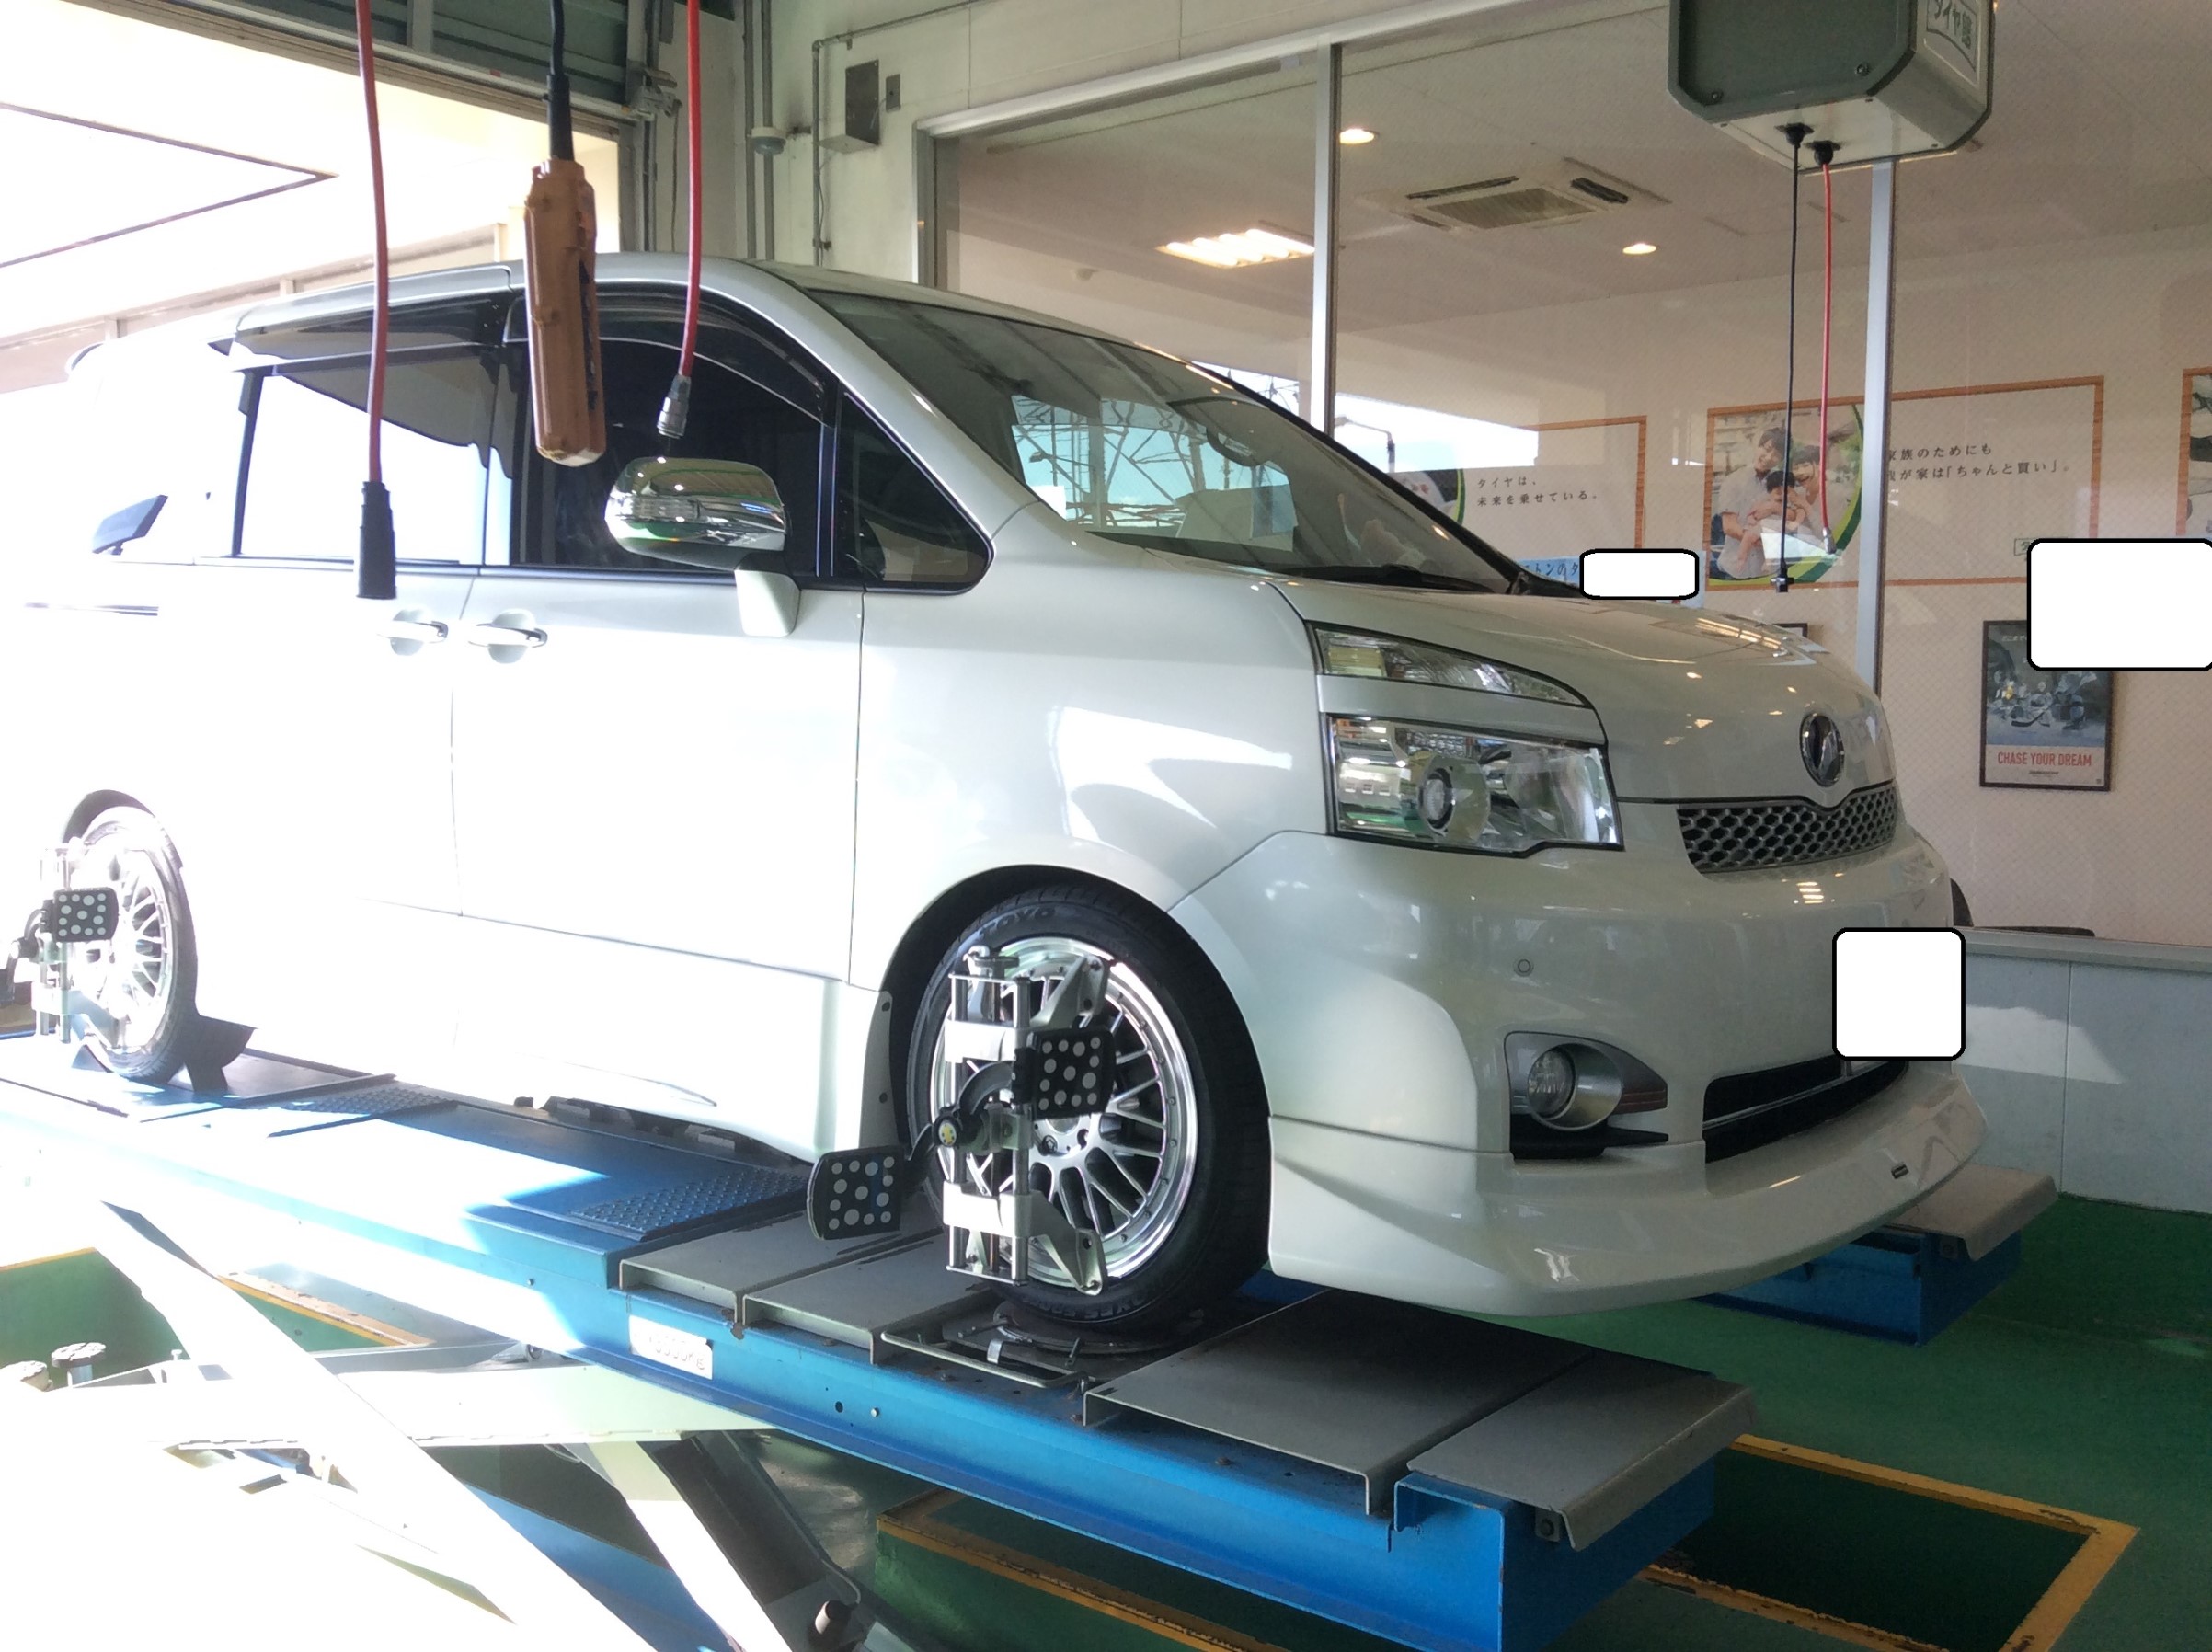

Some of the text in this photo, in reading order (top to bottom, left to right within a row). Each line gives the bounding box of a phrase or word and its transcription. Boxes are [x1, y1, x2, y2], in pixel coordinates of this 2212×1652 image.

[1477, 476, 1536, 488] タイヤは、
[1477, 490, 1598, 507] 未来を乗せている。
[1997, 751, 2092, 767] CHASE YOUR DREAM
